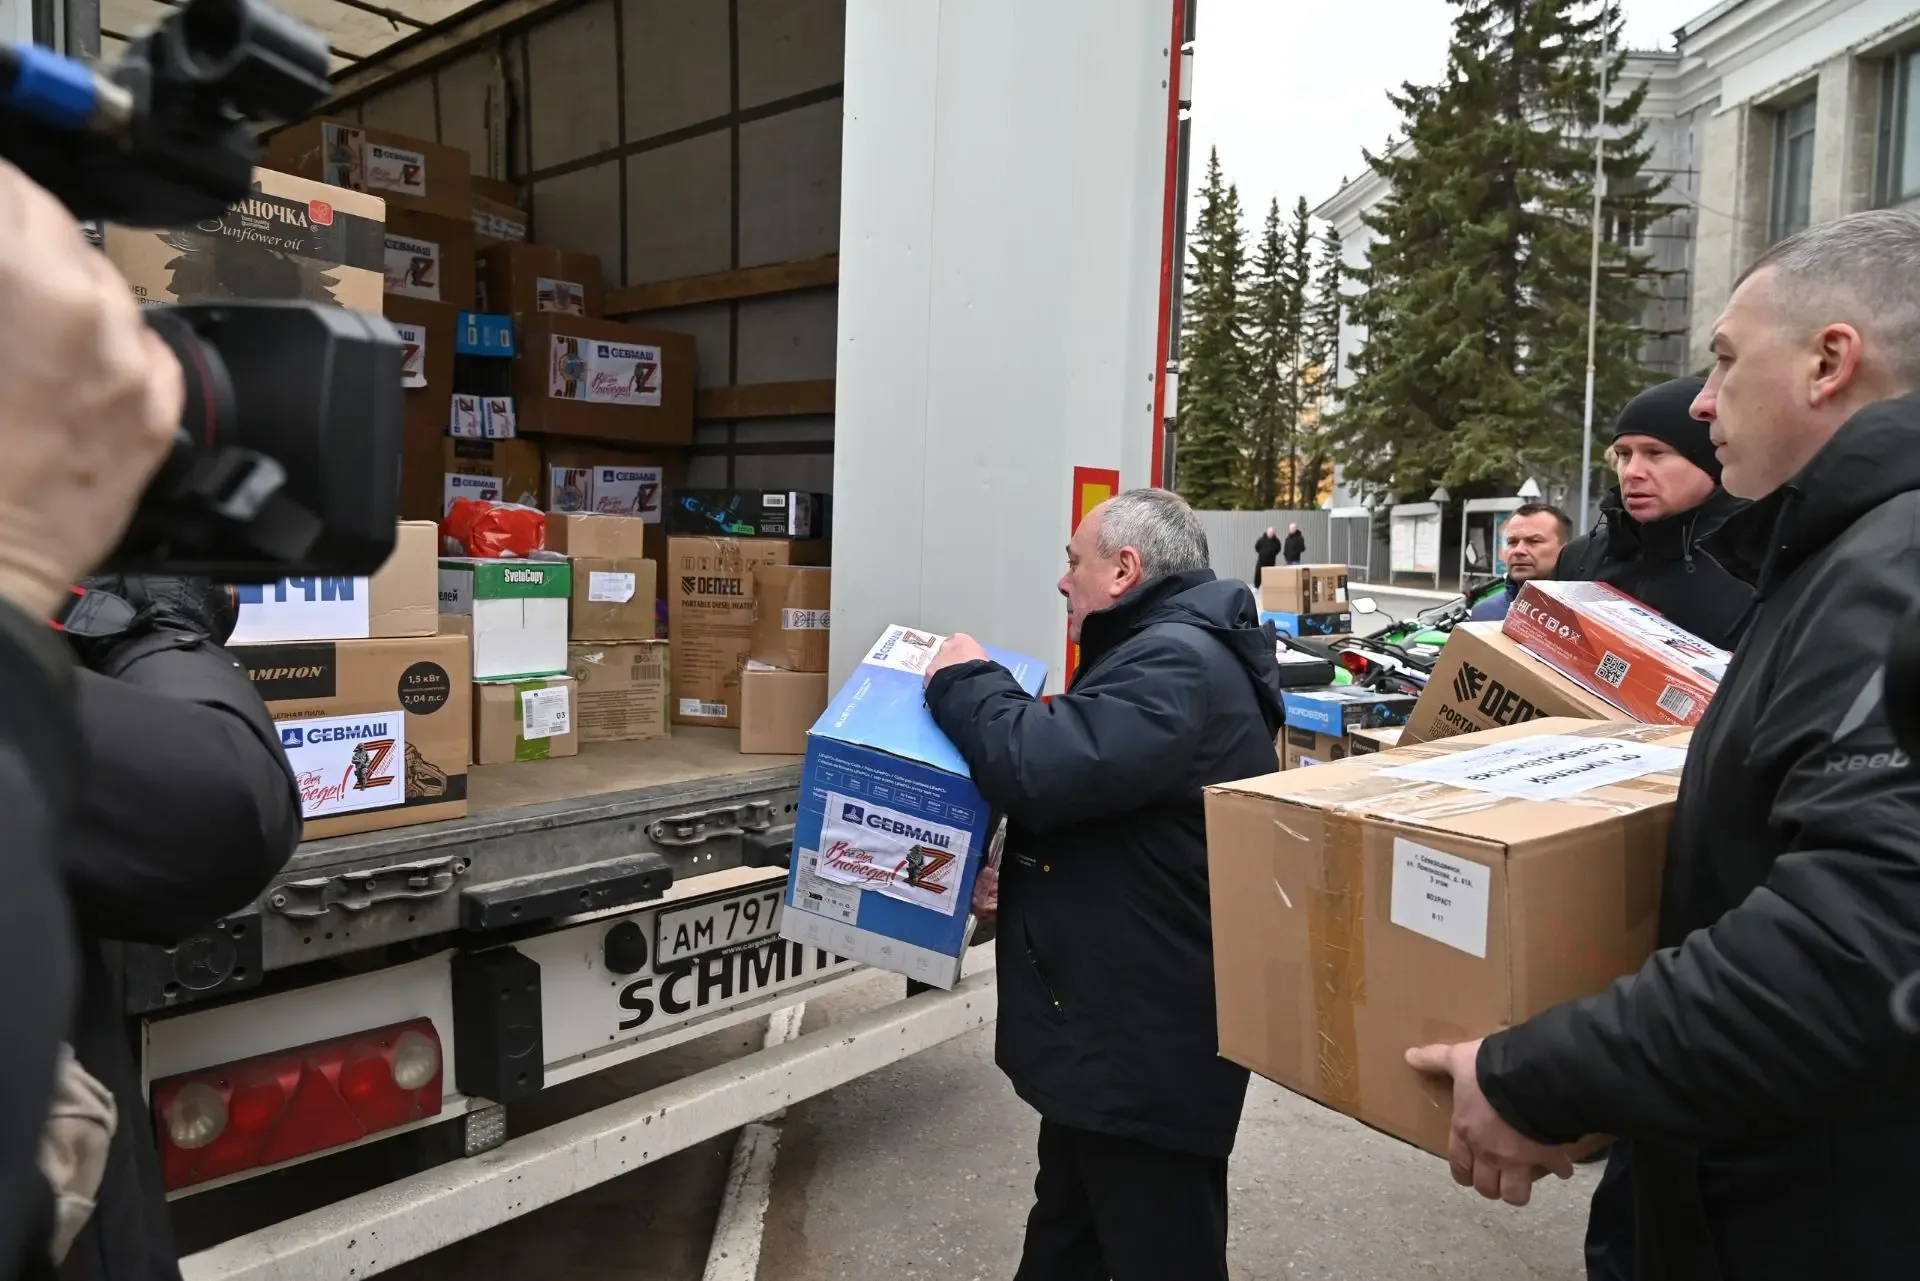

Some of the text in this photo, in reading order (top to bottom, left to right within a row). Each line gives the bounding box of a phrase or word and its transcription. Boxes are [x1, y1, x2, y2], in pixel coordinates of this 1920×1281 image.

[611, 348, 654, 361] СЕВМАШ
[504, 568, 544, 585] SvetoCopy
[697, 576, 745, 596] DENZEL
[404, 694, 425, 704] 2,04
[307, 722, 387, 744] СЕВМАШ
[866, 813, 951, 849] СЕВМАШ
[723, 891, 780, 941] 797
[618, 938, 850, 1031] SCHMI
